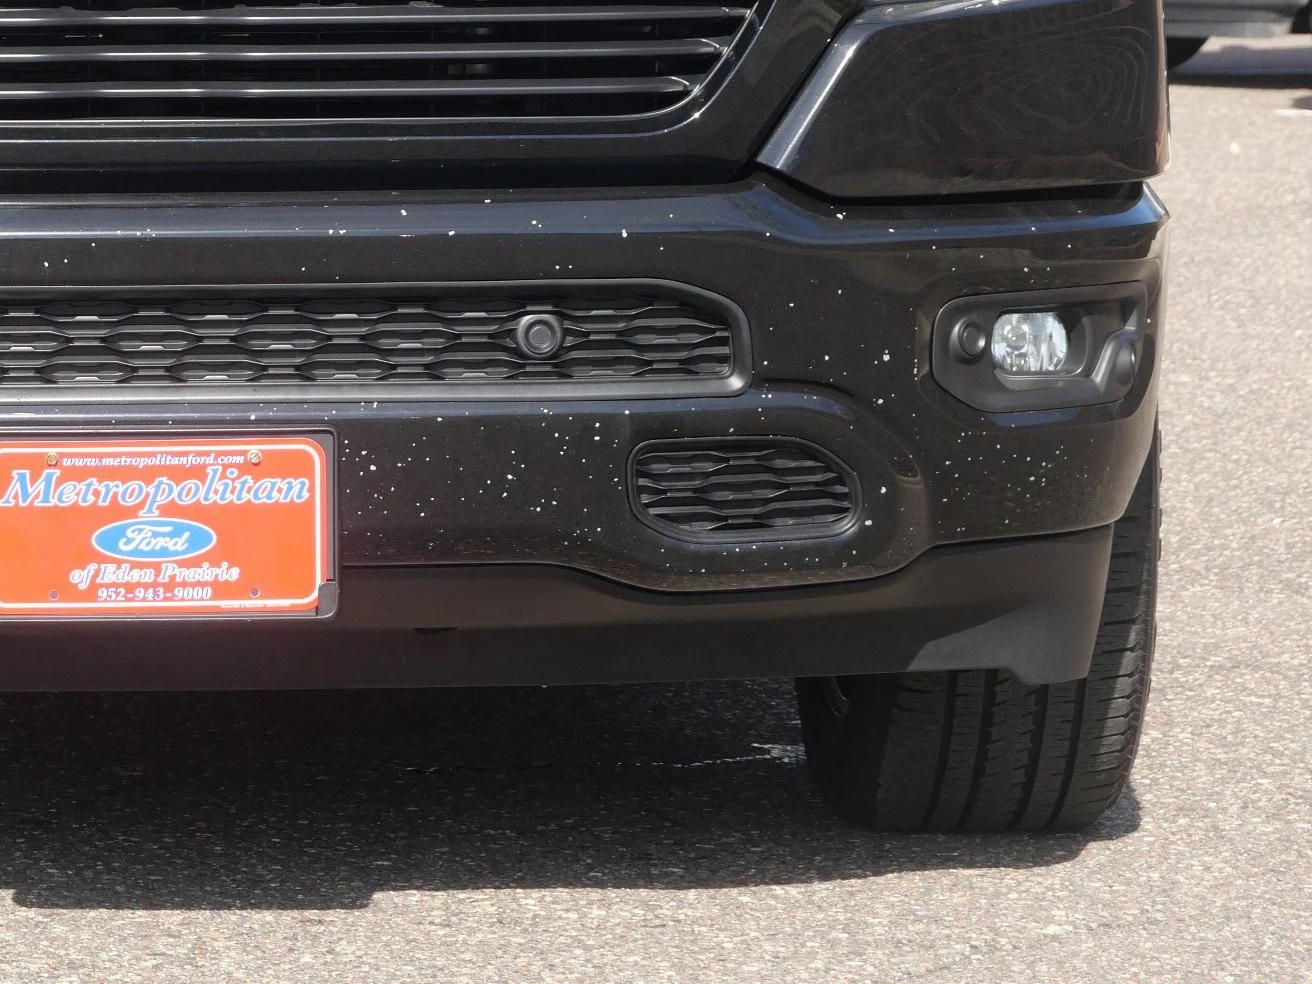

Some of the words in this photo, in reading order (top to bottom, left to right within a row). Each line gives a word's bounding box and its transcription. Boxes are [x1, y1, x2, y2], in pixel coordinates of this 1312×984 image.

[62, 453, 245, 468] www.metropolitanford.com
[118, 524, 190, 552] Ford
[69, 563, 99, 590] of
[97, 563, 155, 584] Eden
[158, 561, 240, 584] Prairie
[97, 587, 213, 601] 952-943-9000
